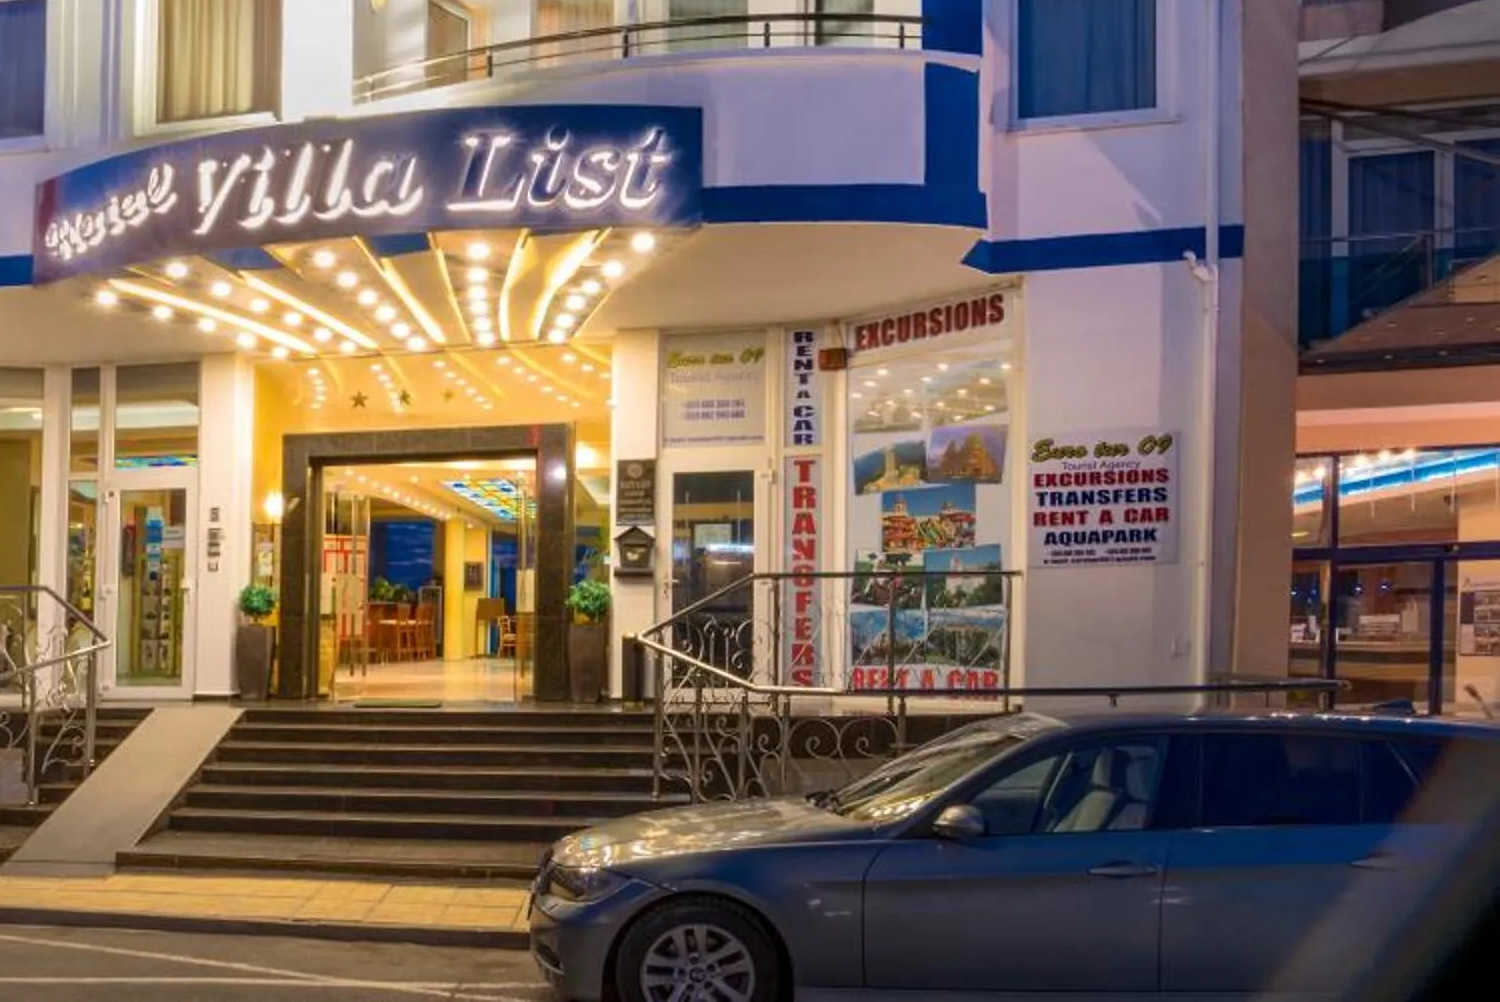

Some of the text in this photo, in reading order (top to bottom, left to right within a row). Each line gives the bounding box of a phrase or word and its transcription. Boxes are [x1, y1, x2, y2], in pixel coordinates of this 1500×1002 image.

[192, 137, 423, 237] Villa
[446, 127, 674, 214] List
[855, 294, 1005, 351] EXCURSIONS
[793, 405, 815, 445] CAR
[1137, 434, 1173, 455] 09
[1062, 460, 1141, 471] Tourist Agency
[1033, 468, 1170, 488] EXCURSIONS
[1036, 487, 1168, 507] TRANSFERS
[1033, 507, 1170, 527] RENT A CAR
[1044, 528, 1158, 546] AQUAPARK
[791, 459, 817, 687] TRANSFERS
